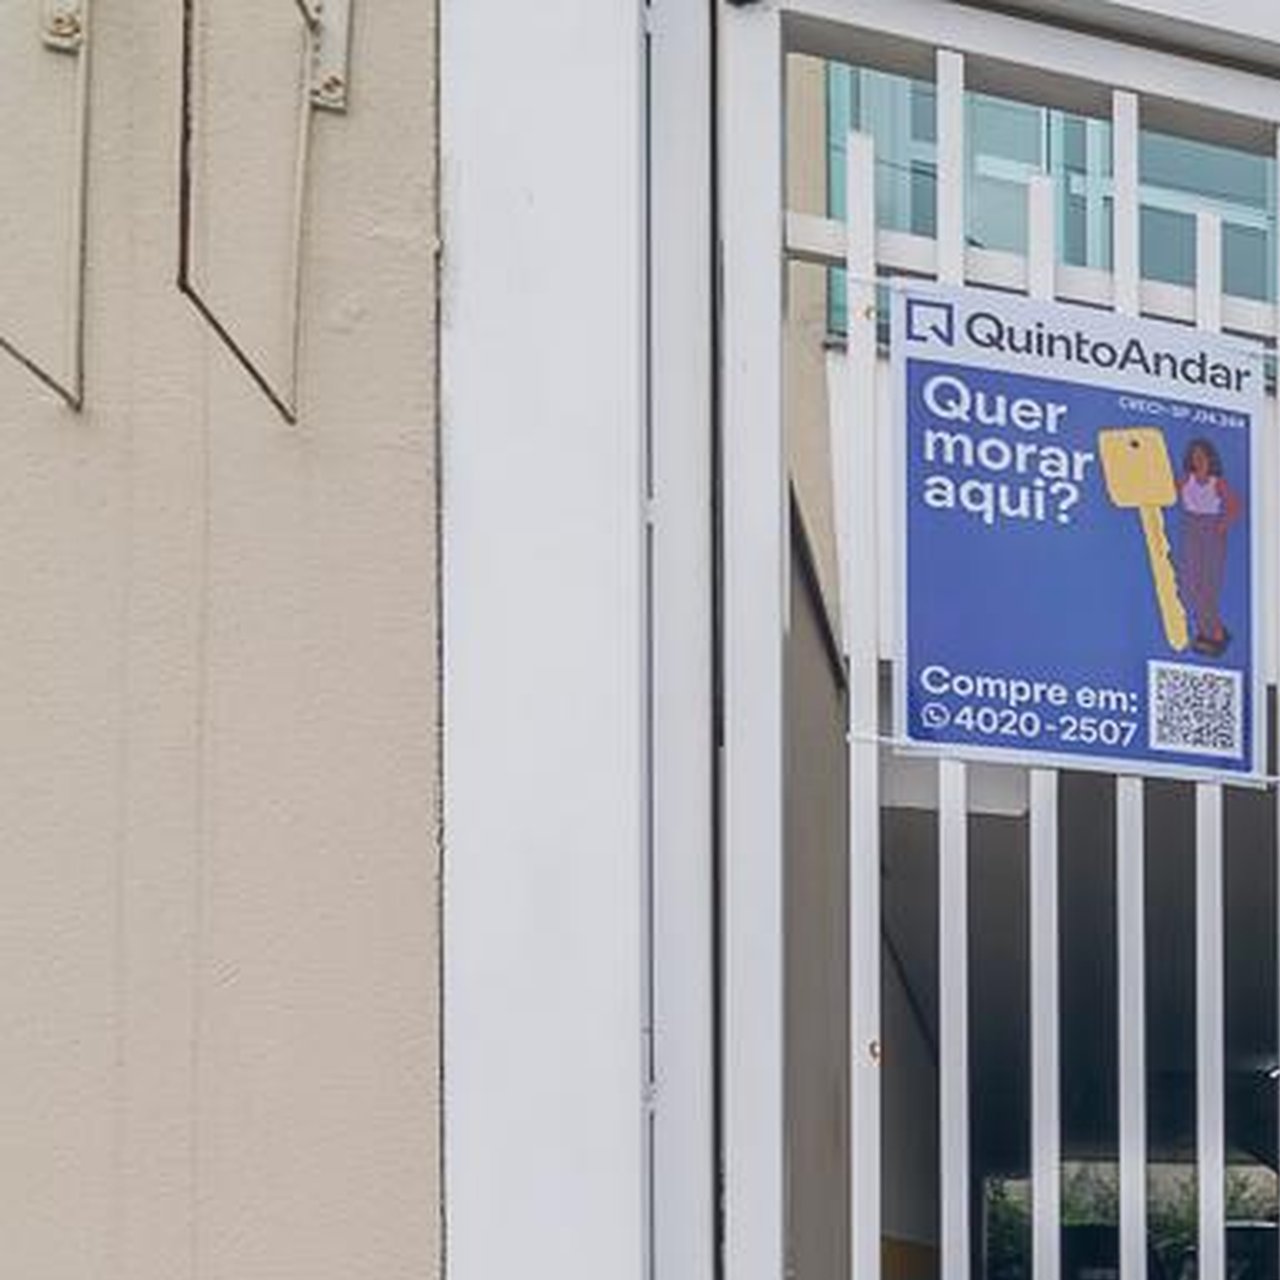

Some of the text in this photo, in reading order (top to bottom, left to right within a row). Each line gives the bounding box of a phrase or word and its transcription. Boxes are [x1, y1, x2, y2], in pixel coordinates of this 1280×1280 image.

[965, 312, 1251, 392] QuintoAndar
[923, 375, 1067, 433] Quer
[923, 428, 1093, 482] morar
[923, 474, 1080, 524] aqui?
[920, 665, 1139, 713] Compre em:
[953, 706, 1138, 747] 4020-2507
